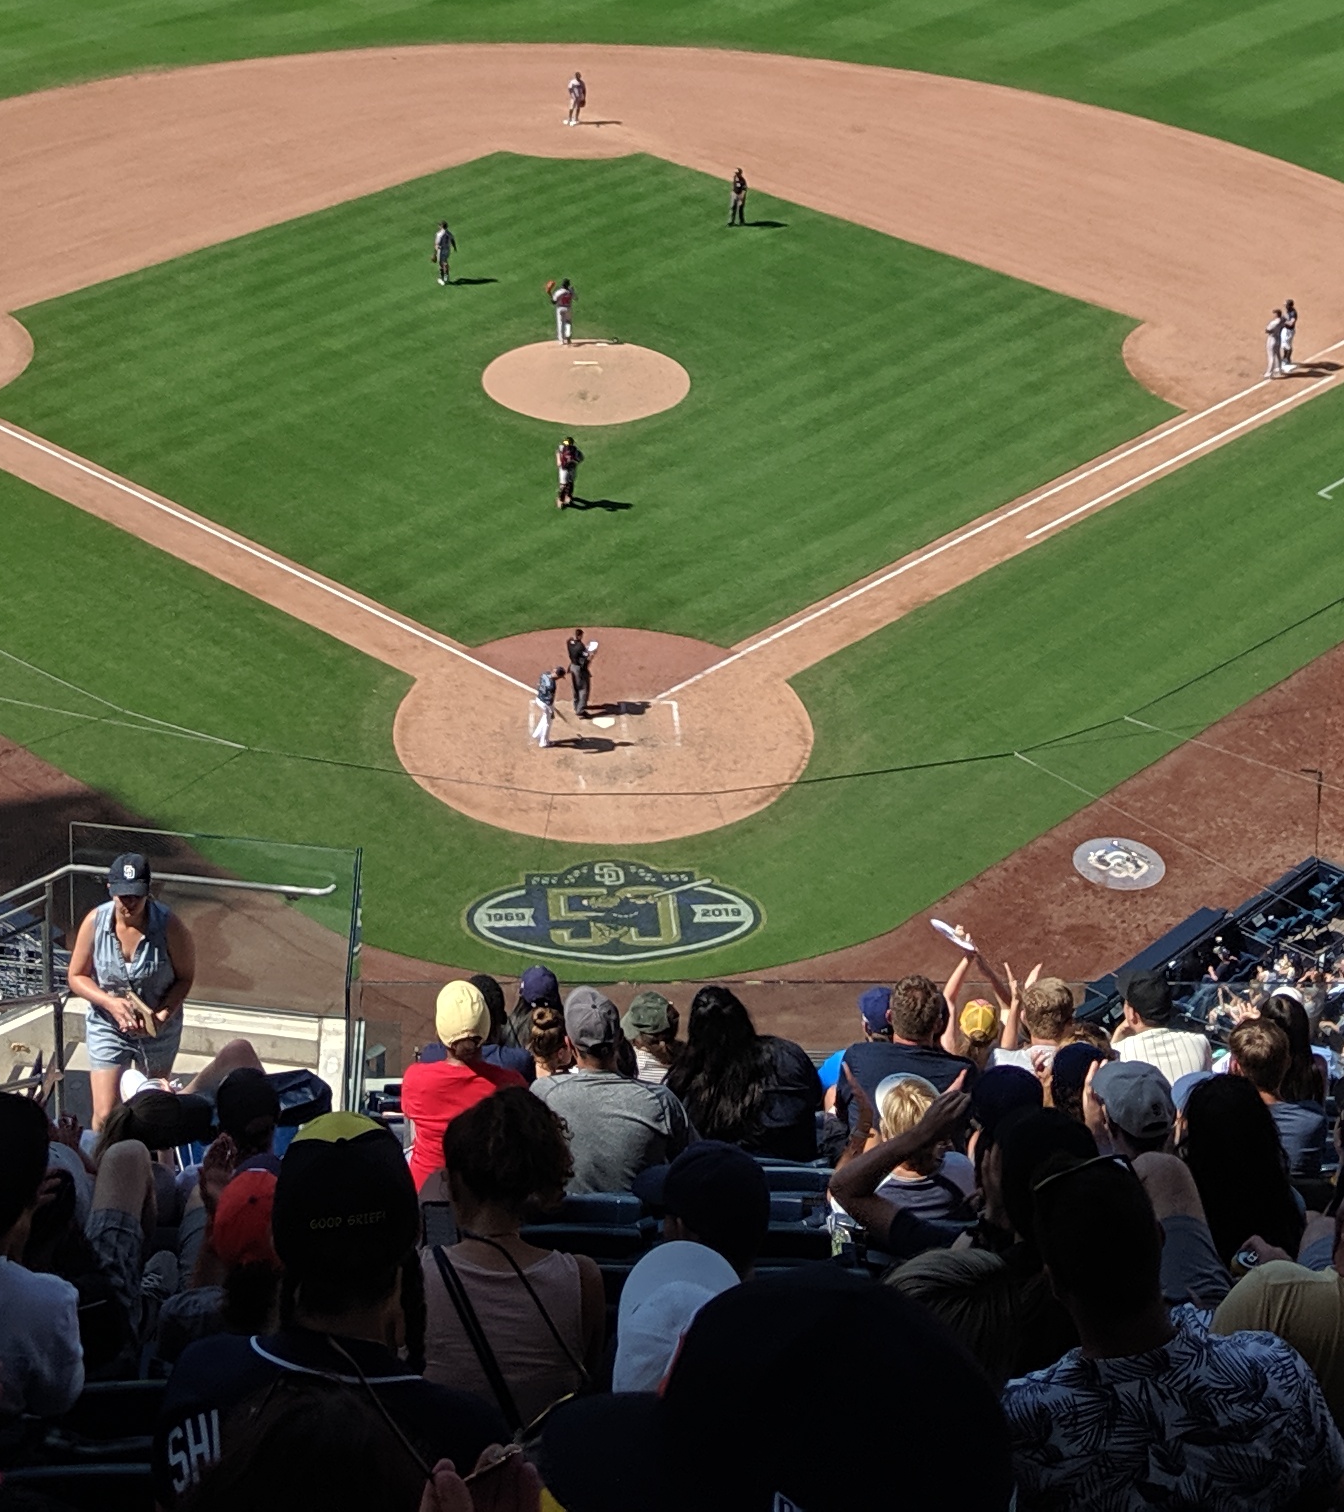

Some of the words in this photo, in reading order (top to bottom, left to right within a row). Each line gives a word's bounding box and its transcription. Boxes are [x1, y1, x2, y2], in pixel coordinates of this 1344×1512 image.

[486, 912, 526, 922] 1969
[700, 907, 742, 918] 2019
[309, 1216, 343, 1229] GOOD
